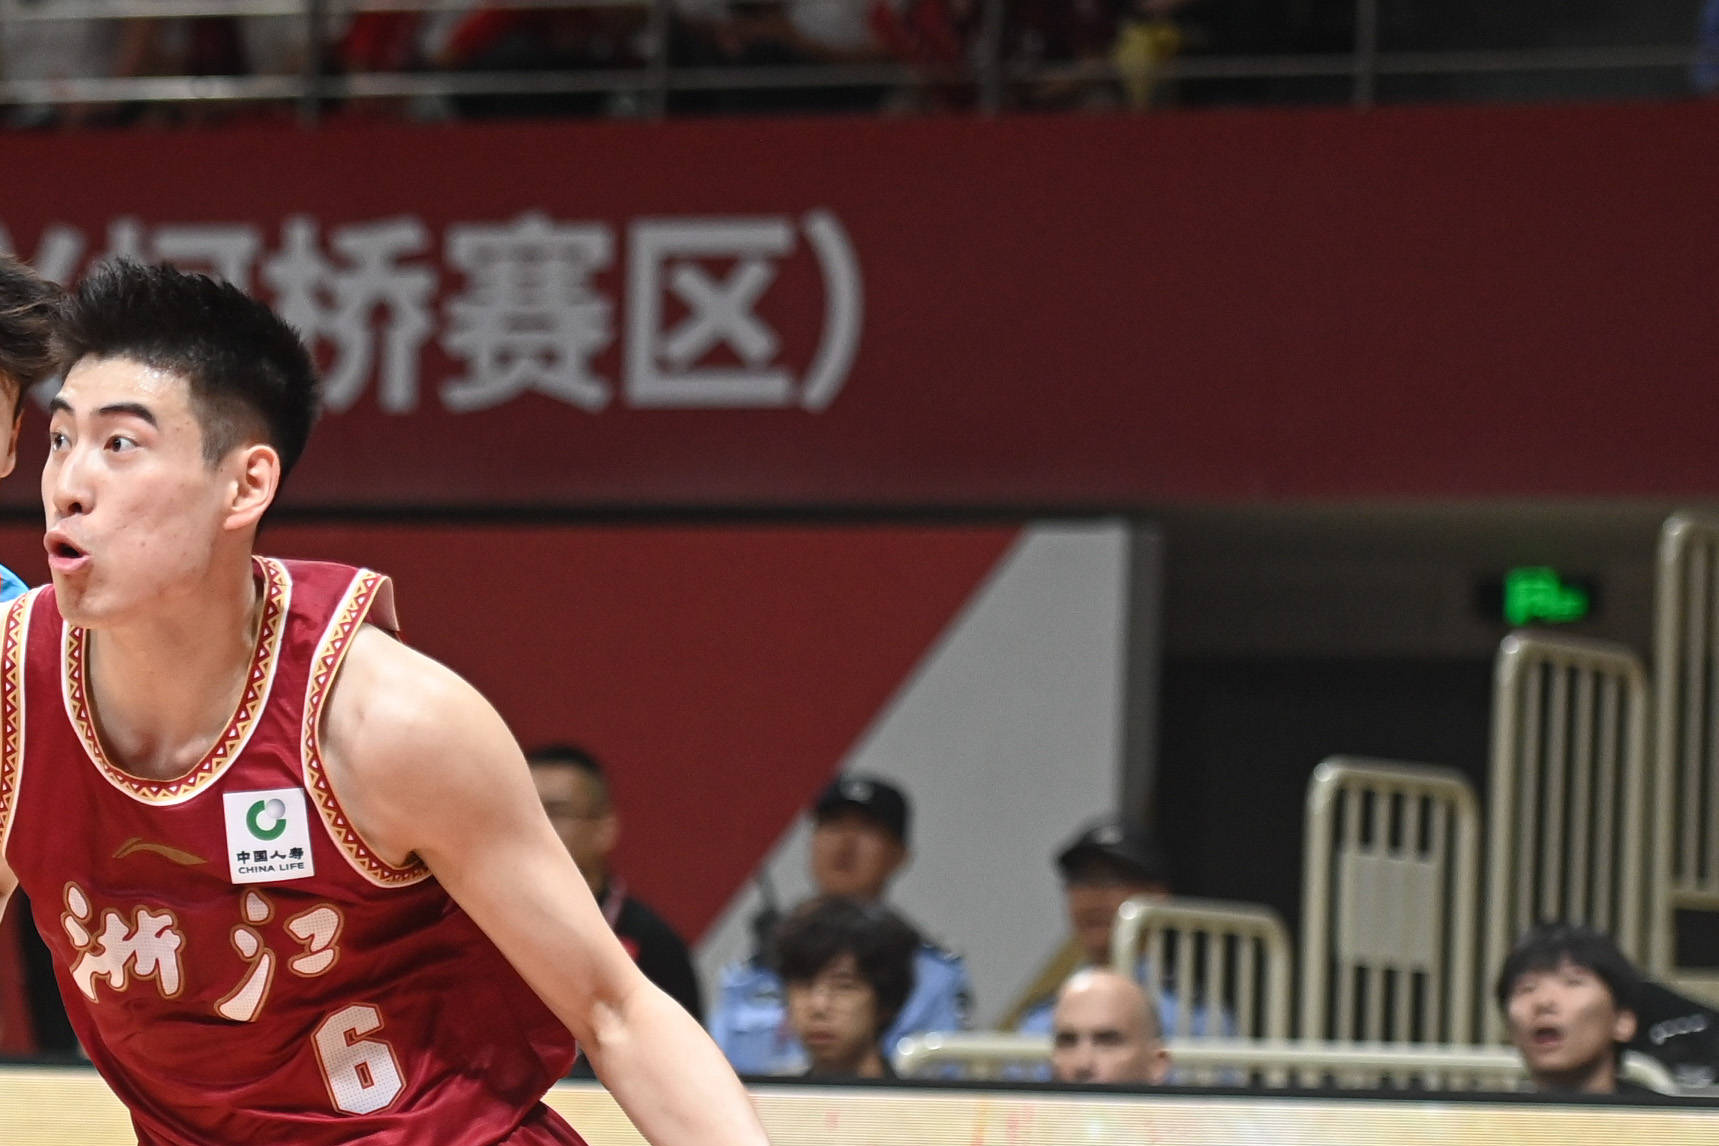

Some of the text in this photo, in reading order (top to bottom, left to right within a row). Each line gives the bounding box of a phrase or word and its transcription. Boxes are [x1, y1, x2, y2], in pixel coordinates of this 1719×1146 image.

[236, 847, 304, 864] 中国人寿
[238, 862, 304, 874] CHINA LIFE
[310, 1003, 407, 1116] 6
